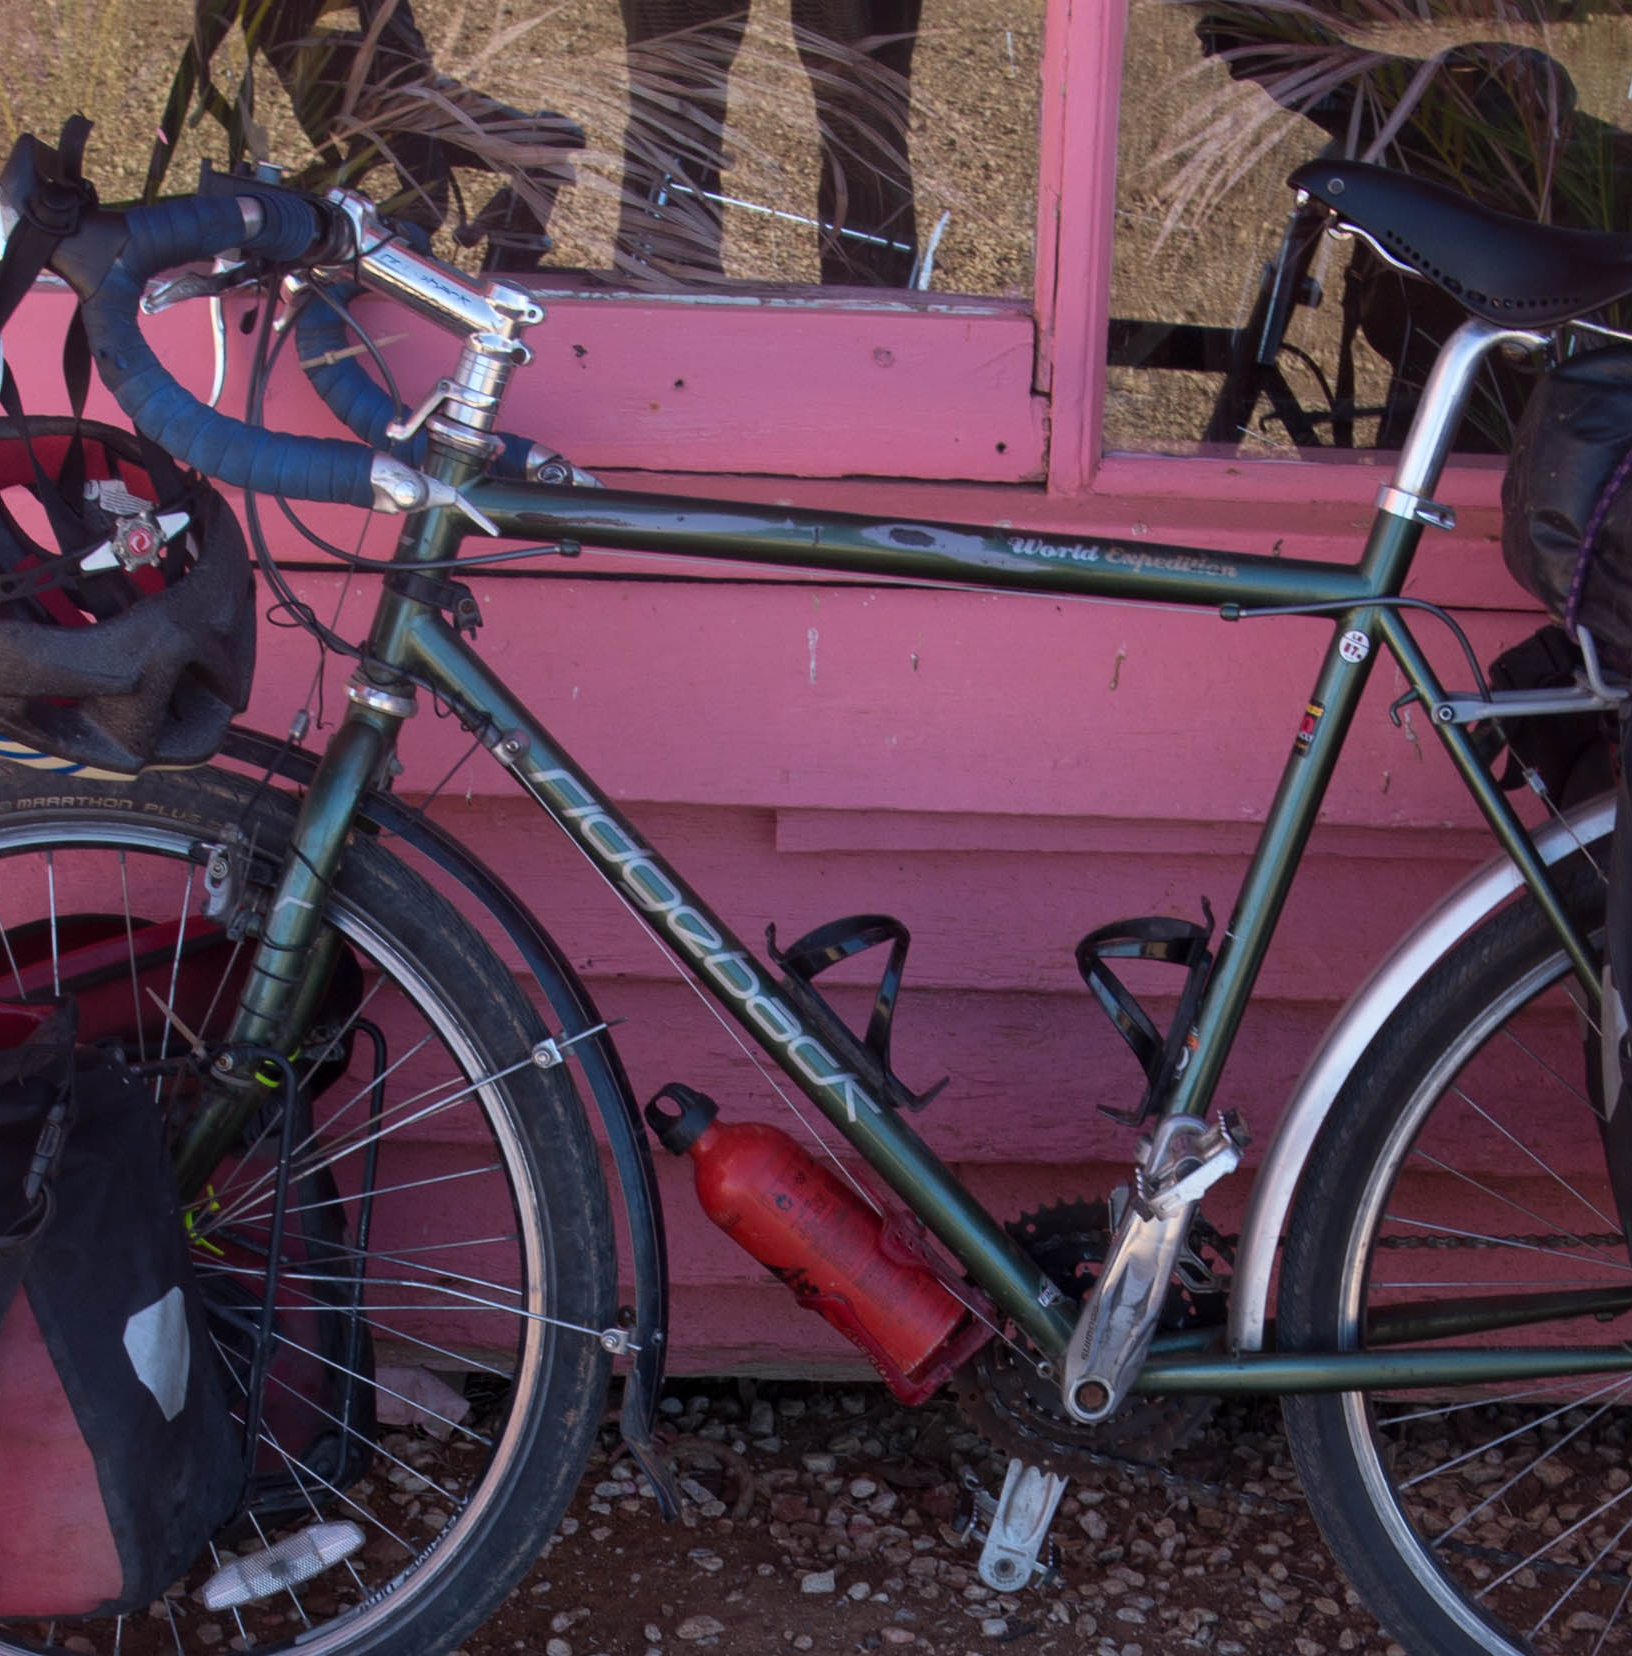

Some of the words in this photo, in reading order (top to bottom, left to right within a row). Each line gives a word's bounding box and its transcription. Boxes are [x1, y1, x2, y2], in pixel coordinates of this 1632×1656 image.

[1008, 537, 1100, 562] World
[1105, 547, 1237, 577] Expedition
[532, 768, 882, 1122] ridgeback
